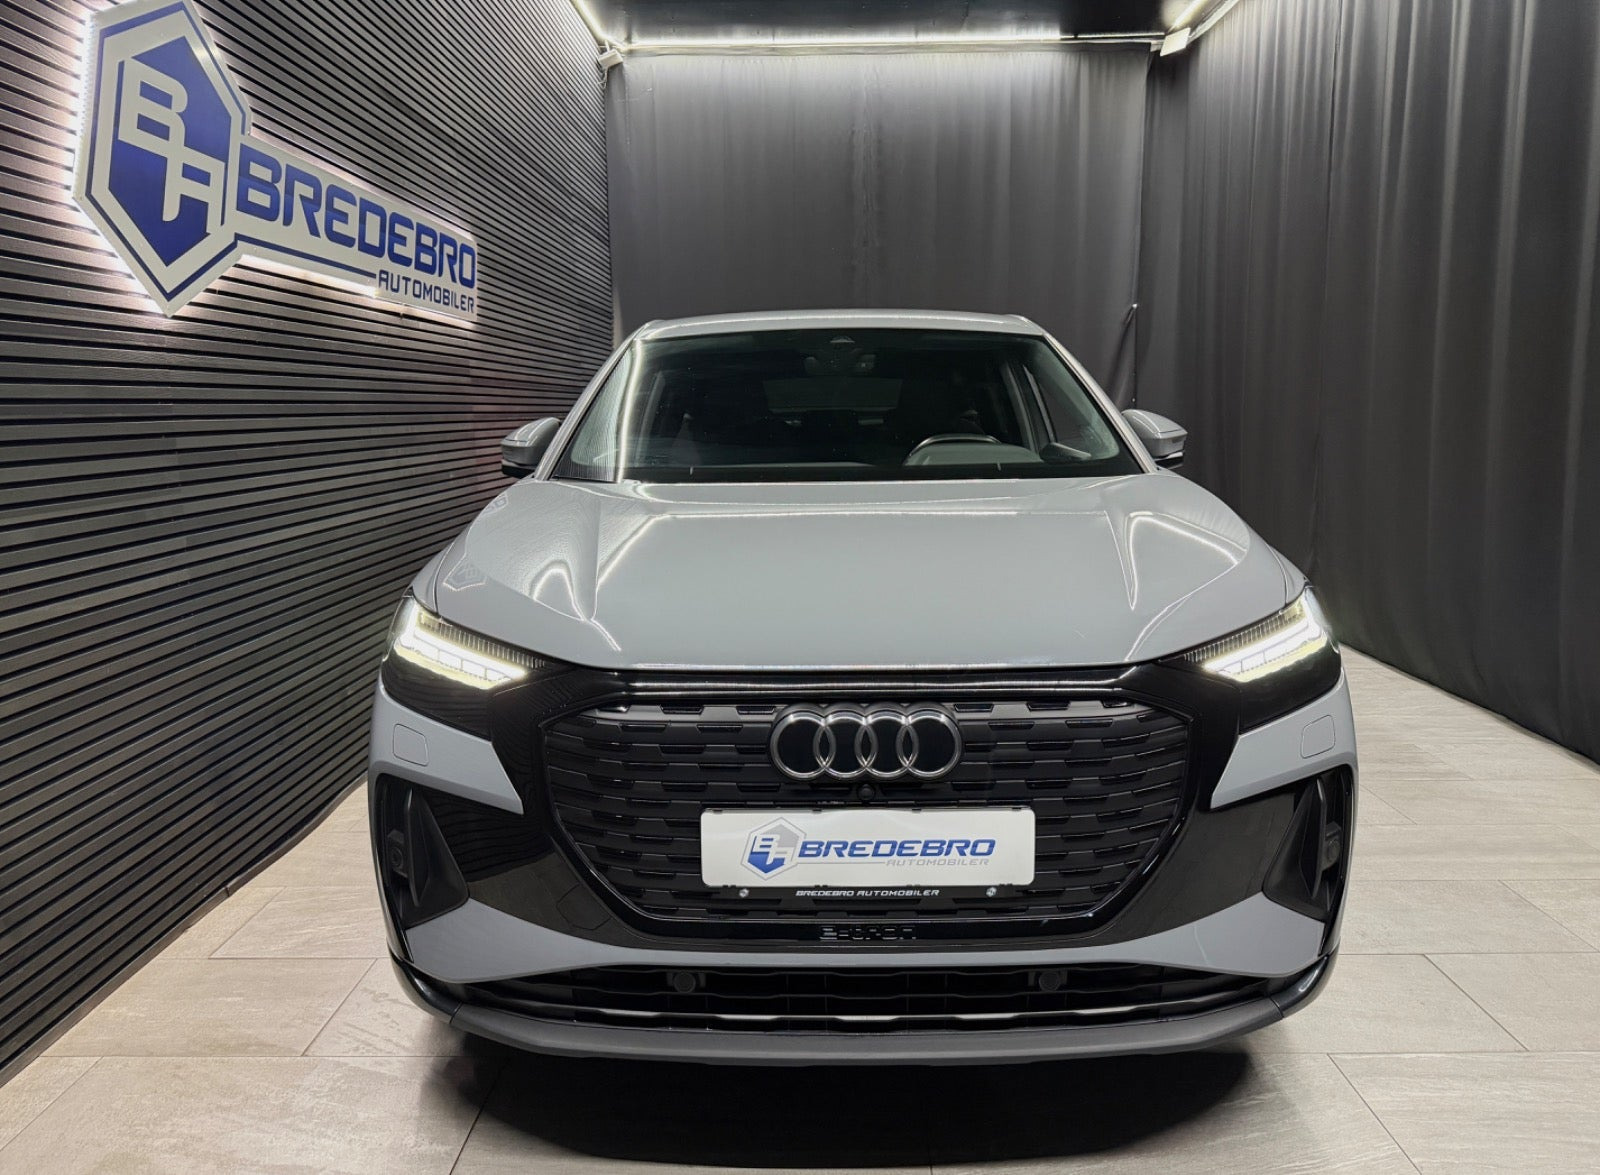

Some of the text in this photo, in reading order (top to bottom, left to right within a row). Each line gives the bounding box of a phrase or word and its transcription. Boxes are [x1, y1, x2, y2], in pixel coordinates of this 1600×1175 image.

[236, 143, 477, 289] BREDEBRO
[378, 270, 475, 313] AUTOMOBILER
[798, 839, 996, 858] BREDEBRO
[885, 858, 989, 867] AUTOMOBILER
[856, 889, 940, 897] AUTOMOBILER
